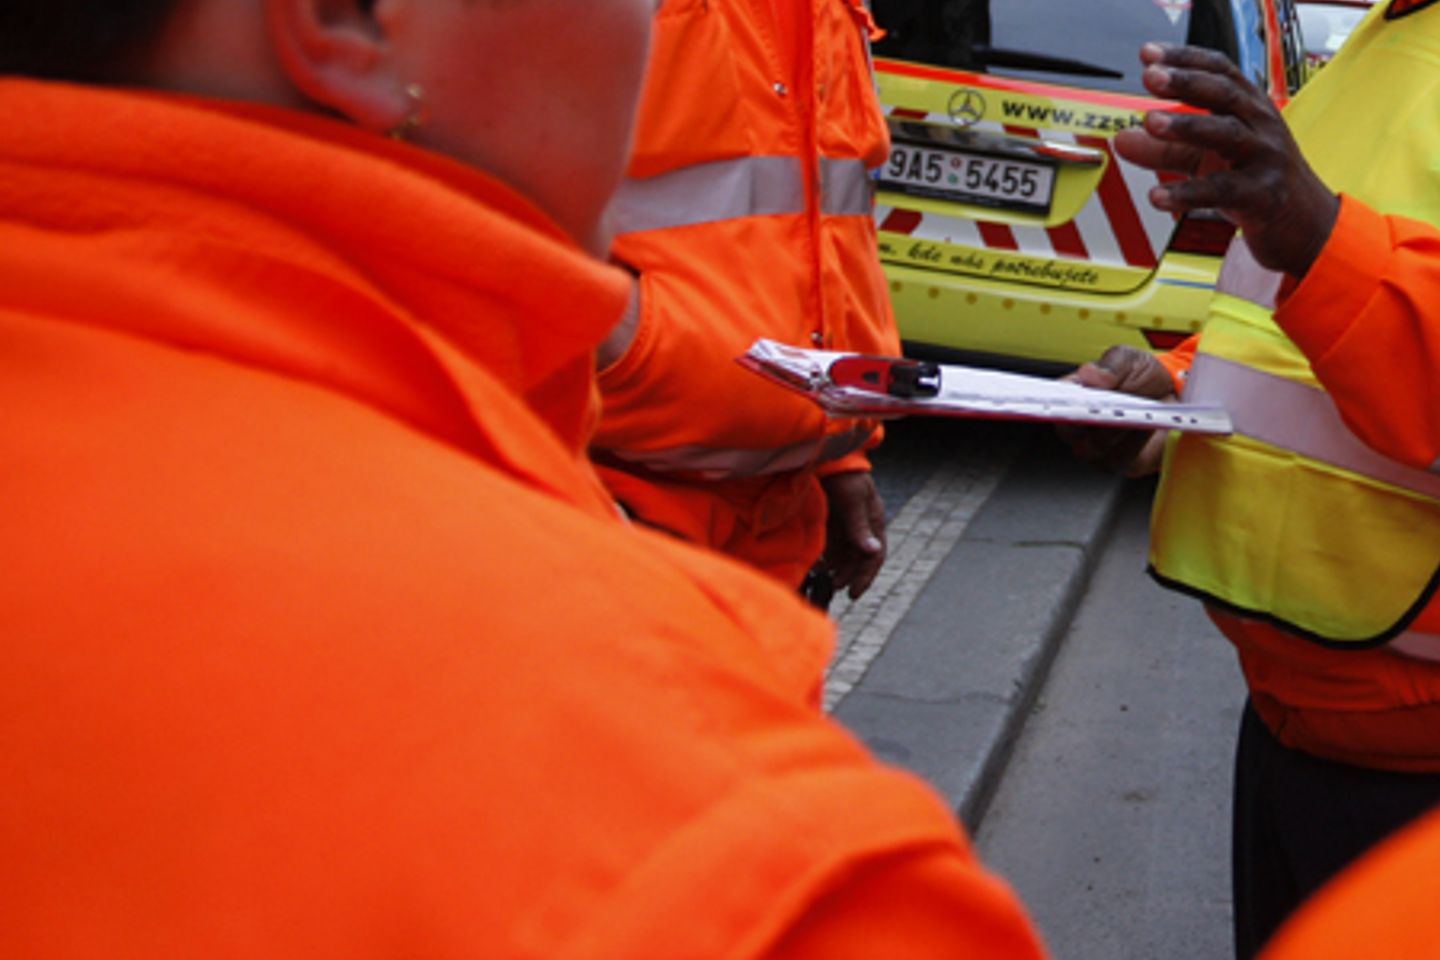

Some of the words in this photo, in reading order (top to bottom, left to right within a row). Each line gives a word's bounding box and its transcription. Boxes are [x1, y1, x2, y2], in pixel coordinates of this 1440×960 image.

[1001, 100, 1145, 132] www.zzsh
[888, 149, 944, 184] 9A5
[965, 159, 1039, 198] 5455
